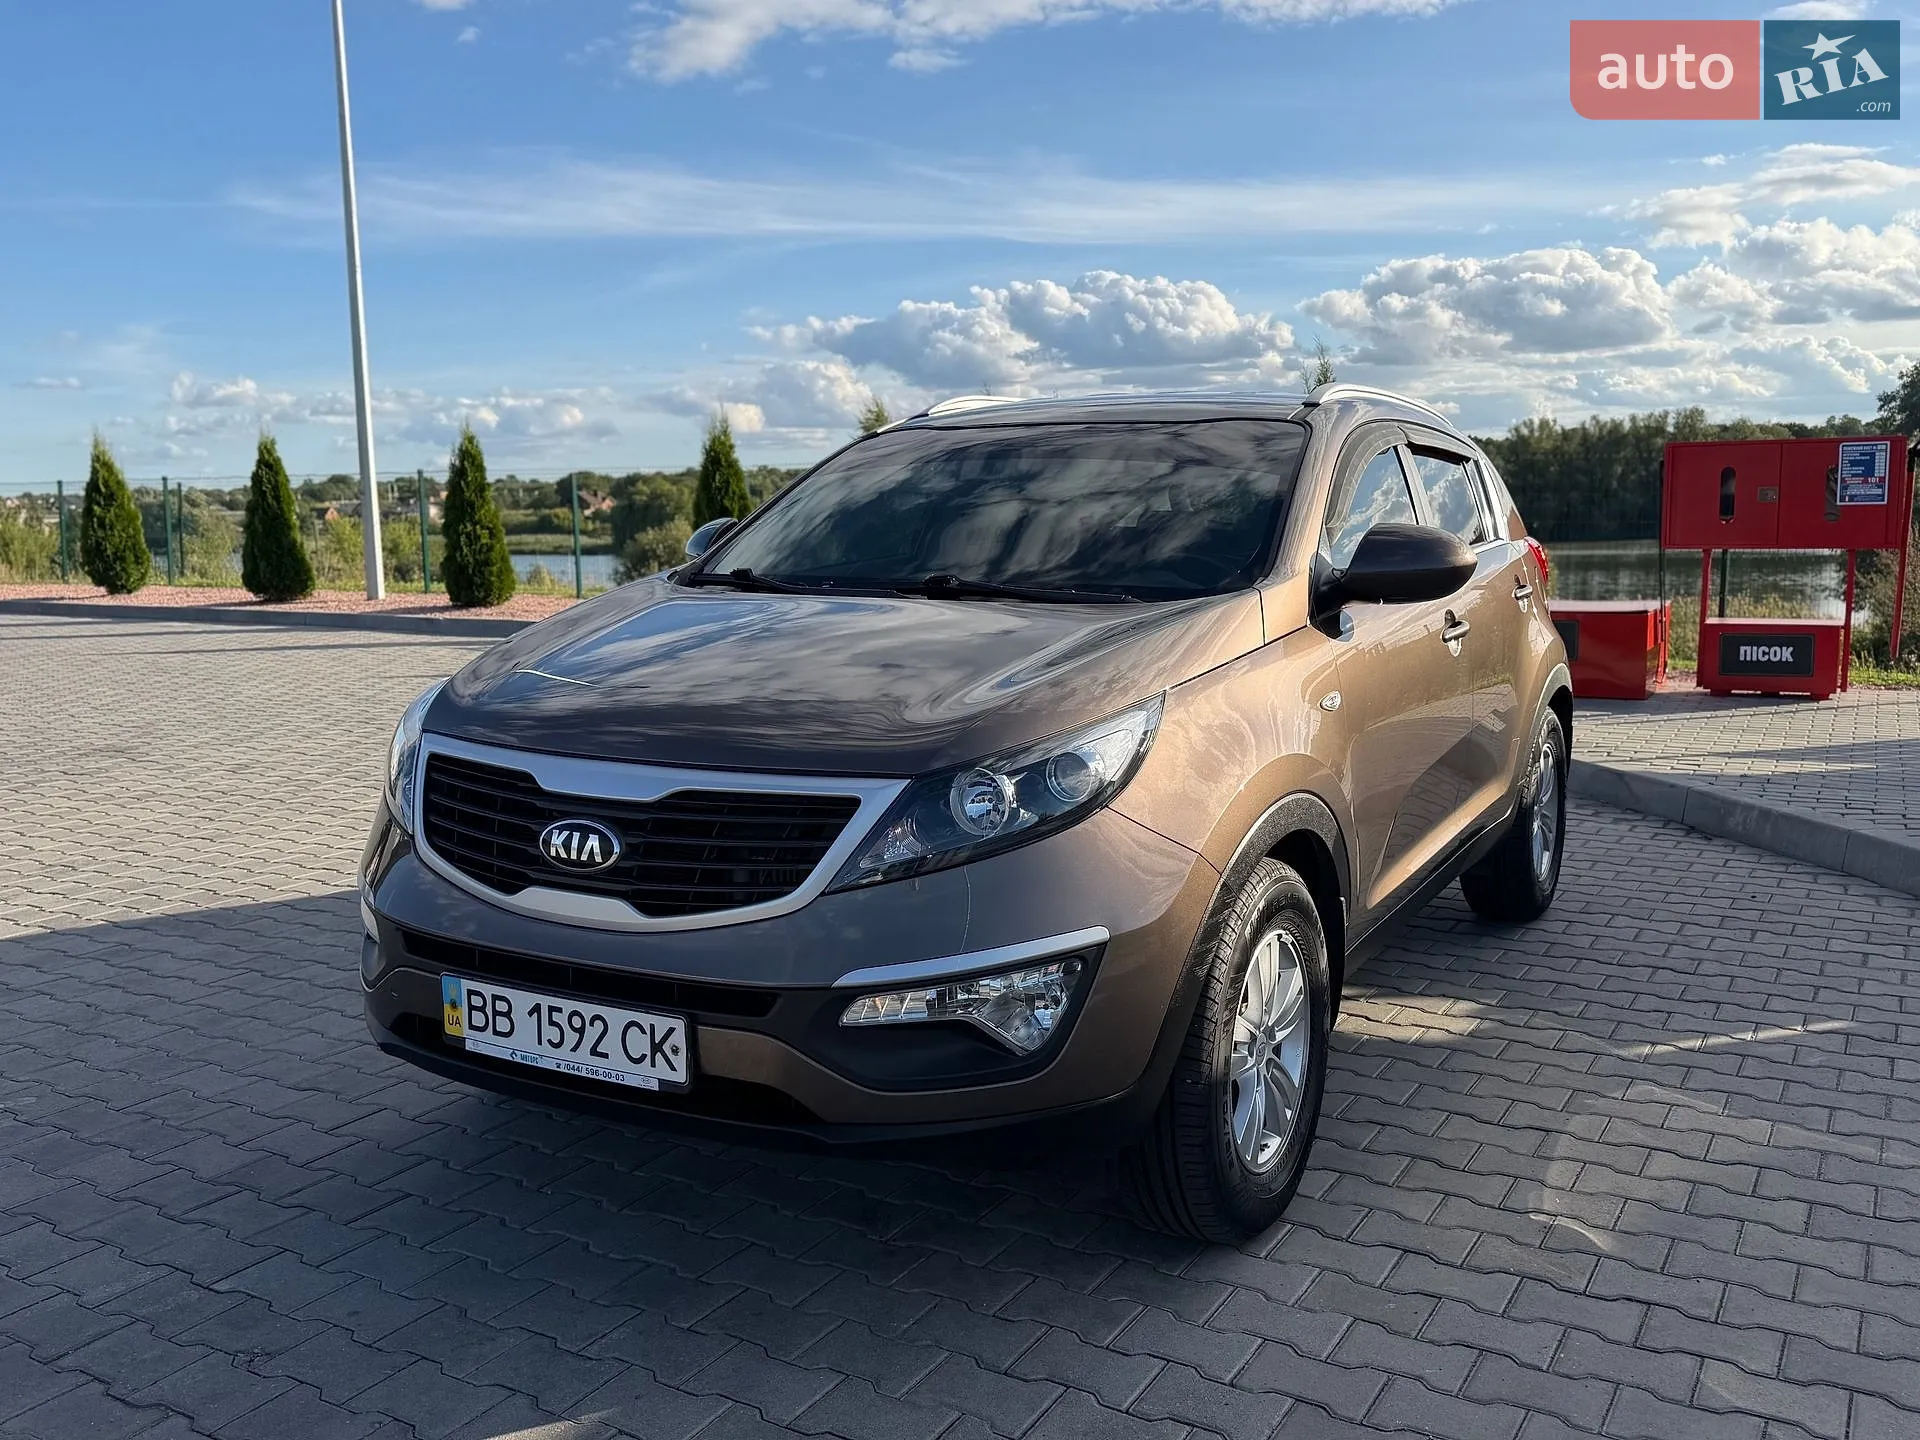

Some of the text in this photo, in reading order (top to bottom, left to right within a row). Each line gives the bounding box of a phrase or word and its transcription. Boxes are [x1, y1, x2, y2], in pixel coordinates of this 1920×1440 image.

[1739, 645, 1794, 662] ПІСОК
[550, 829, 603, 863] KIA
[447, 1014, 462, 1028] UA
[466, 988, 678, 1072] BB 1592 CK
[585, 1067, 625, 1082] 596-00-03
